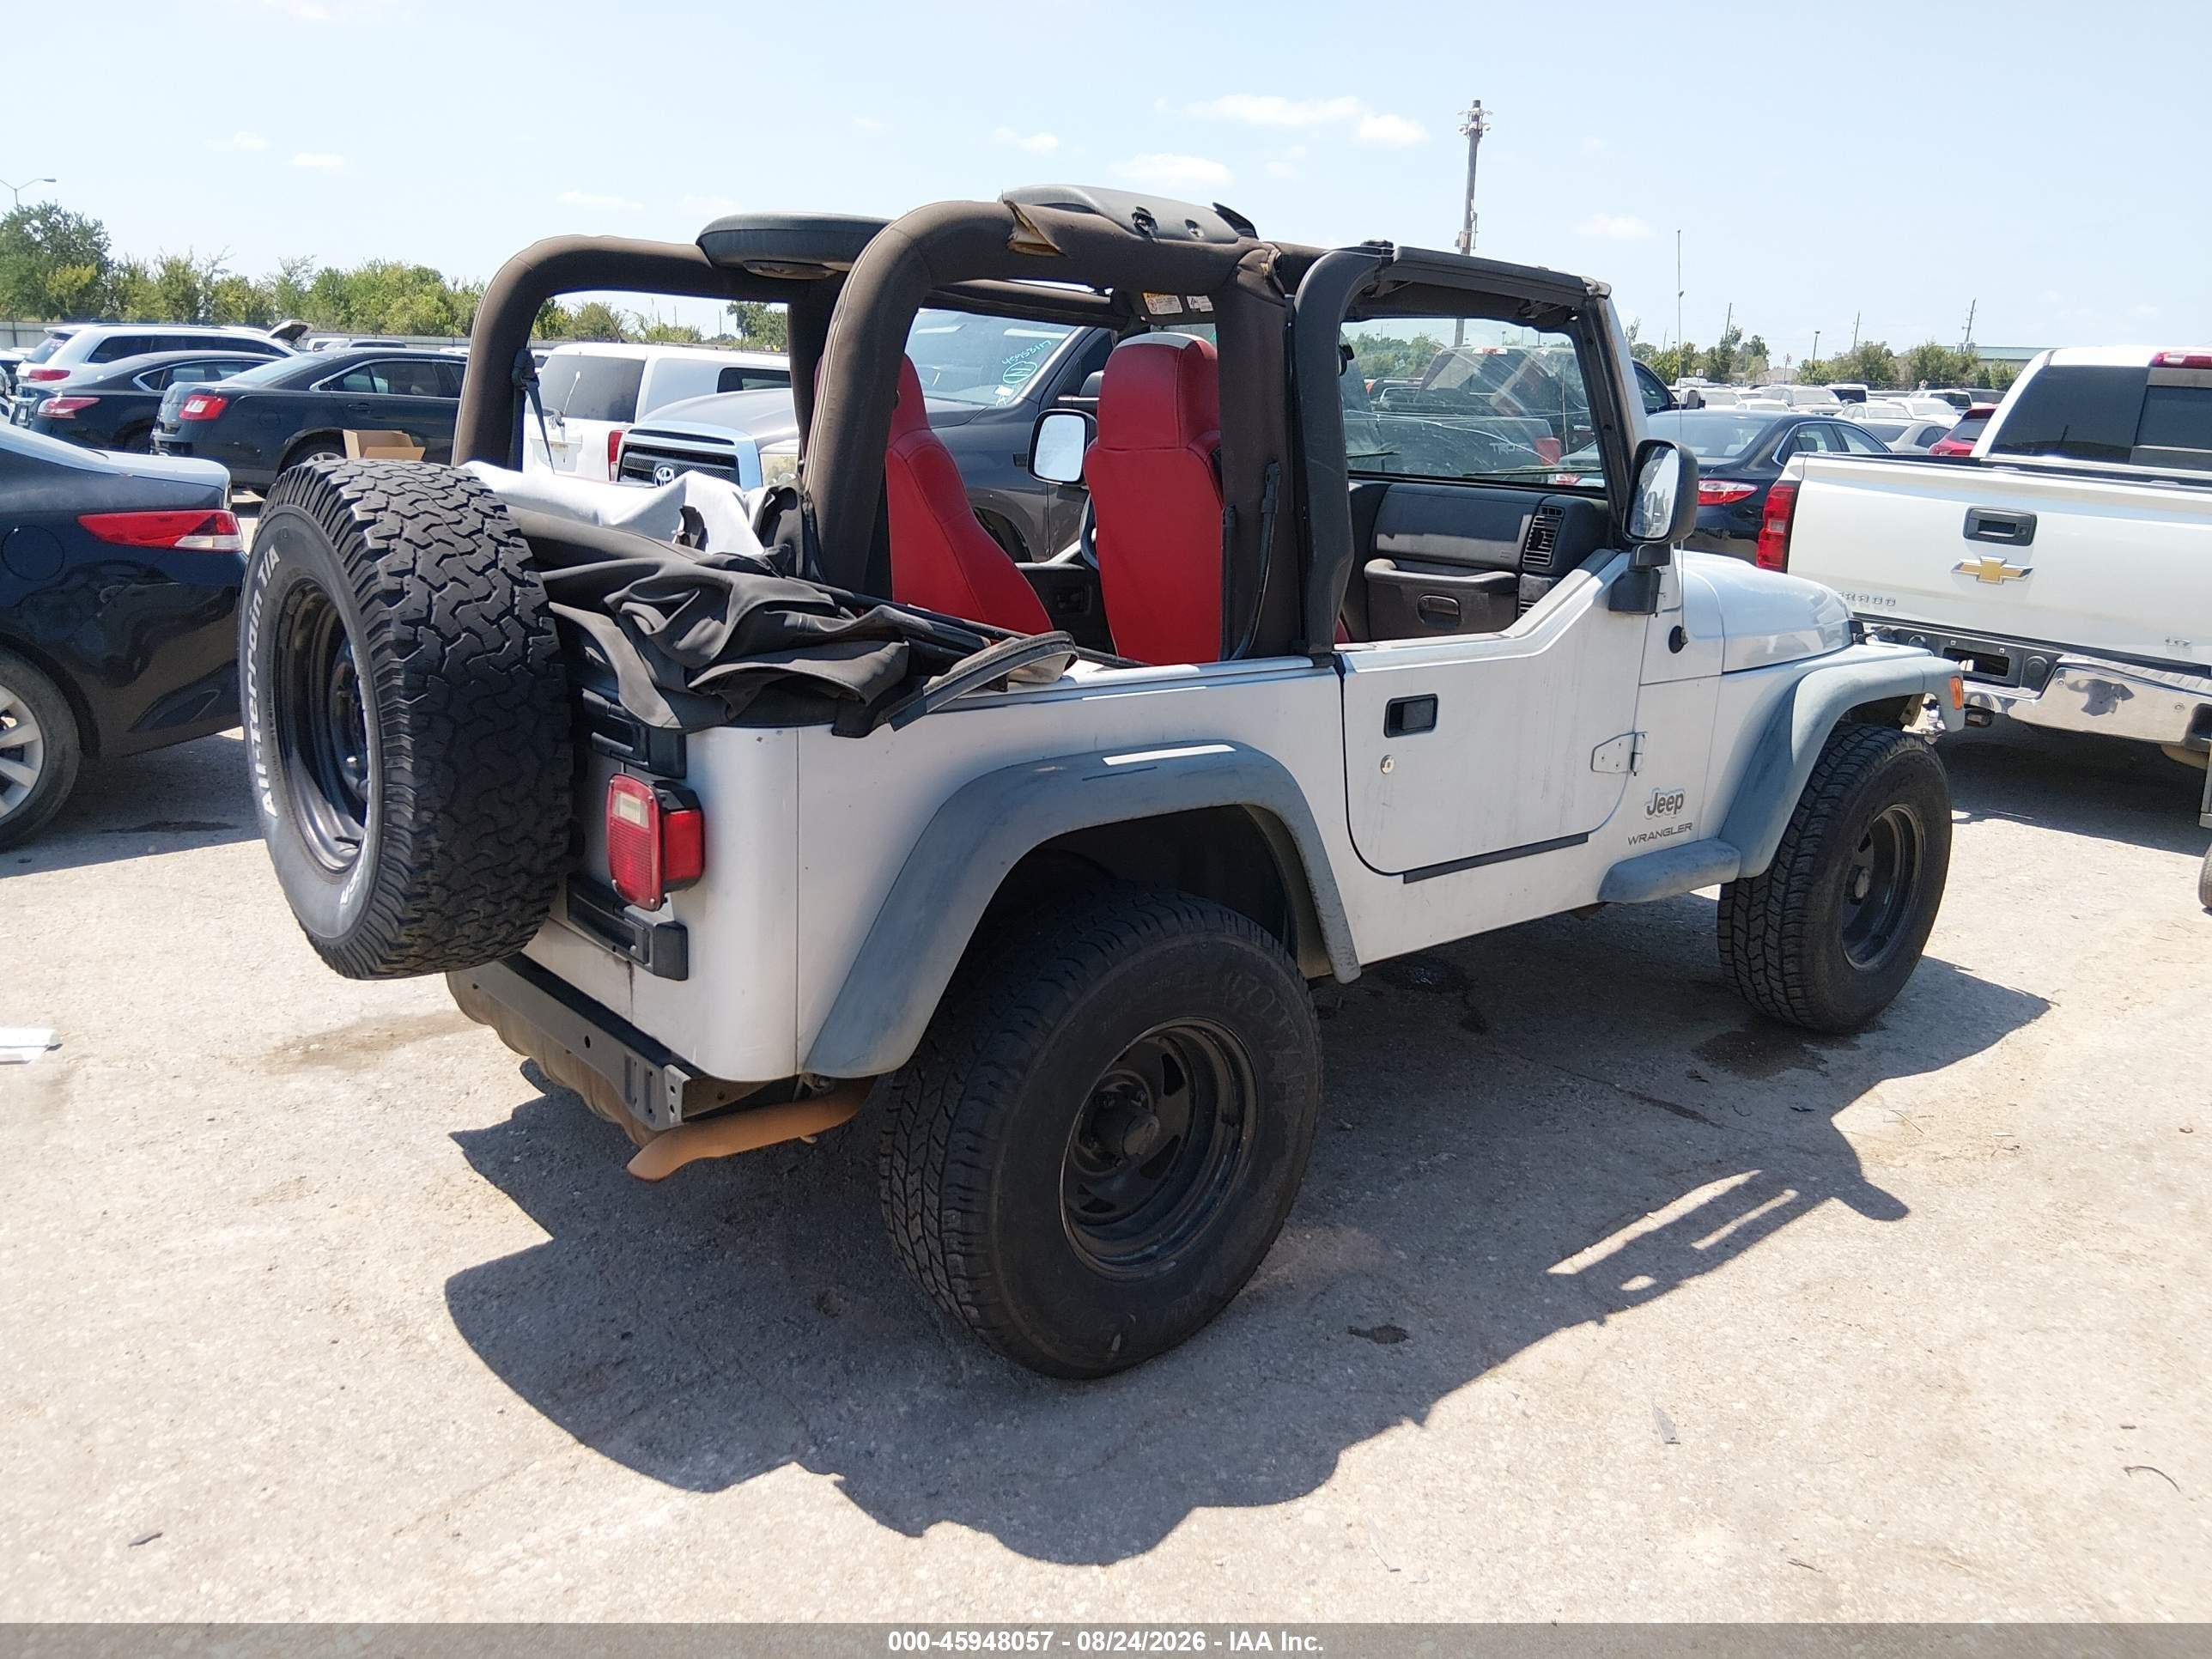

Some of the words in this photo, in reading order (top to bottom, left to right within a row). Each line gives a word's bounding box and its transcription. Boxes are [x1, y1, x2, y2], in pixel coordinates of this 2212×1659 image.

[257, 544, 281, 588] T/A
[1646, 791, 1685, 816] Jeep
[1627, 822, 1692, 846] WRANGLER
